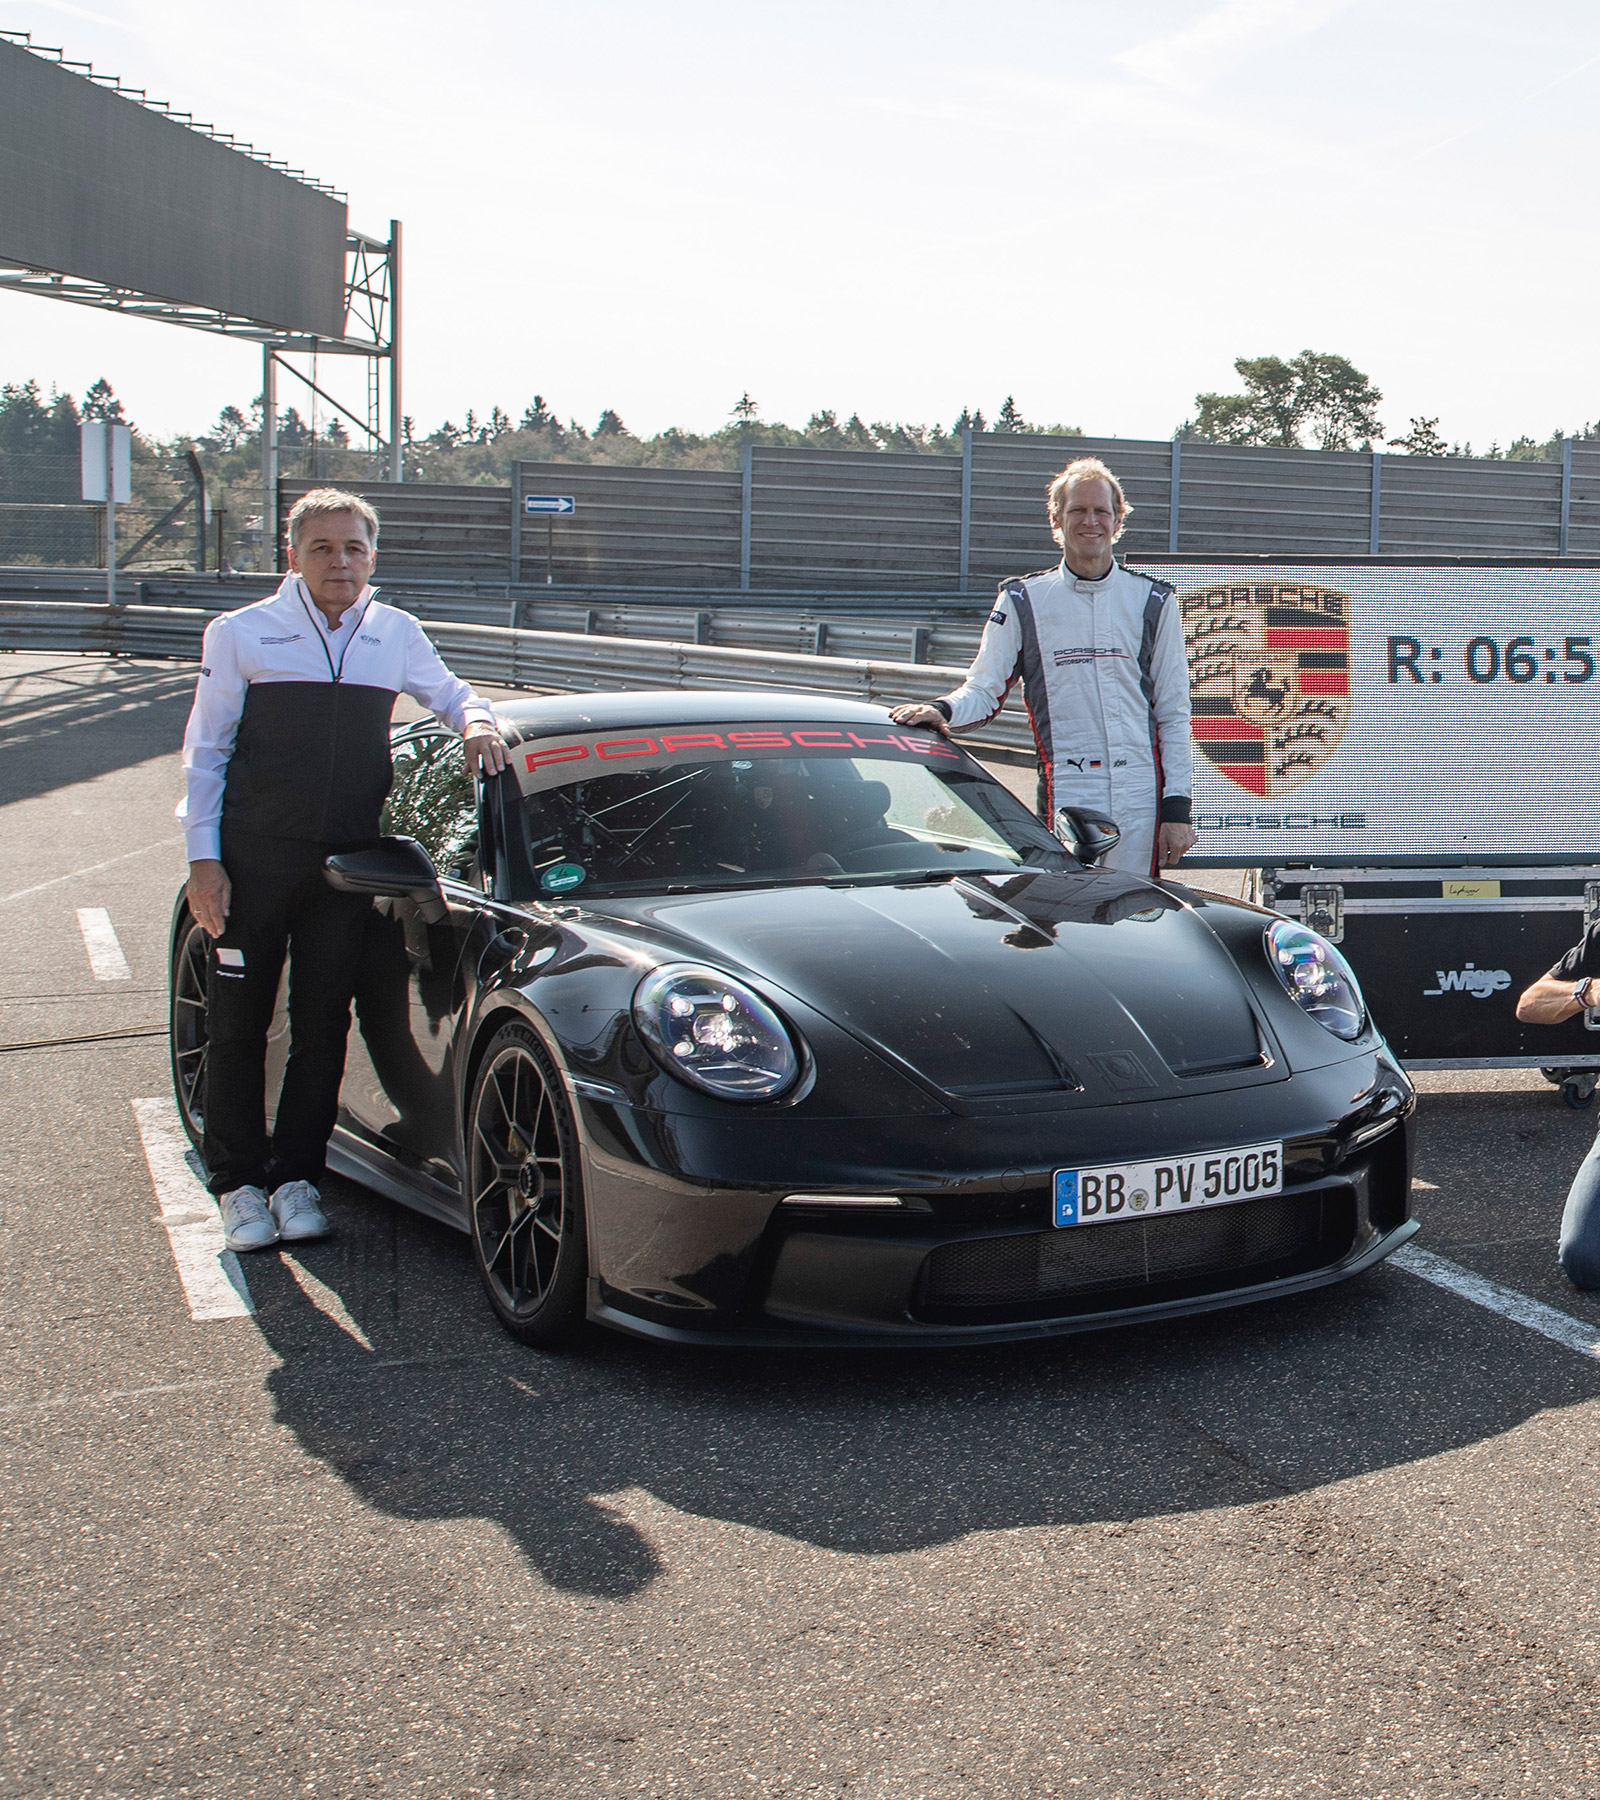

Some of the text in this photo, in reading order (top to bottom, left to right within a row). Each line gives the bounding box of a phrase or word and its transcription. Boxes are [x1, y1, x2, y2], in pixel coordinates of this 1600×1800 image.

[1182, 586, 1344, 618] PORSCHE
[1053, 647, 1123, 657] PORSCHE
[1056, 658, 1093, 667] MOTORSPORT
[1387, 636, 1442, 684] R:
[524, 730, 960, 773] PORSCHE
[1190, 812, 1367, 831] ORSCHE
[1081, 1149, 1278, 1216] BB PV 5005
